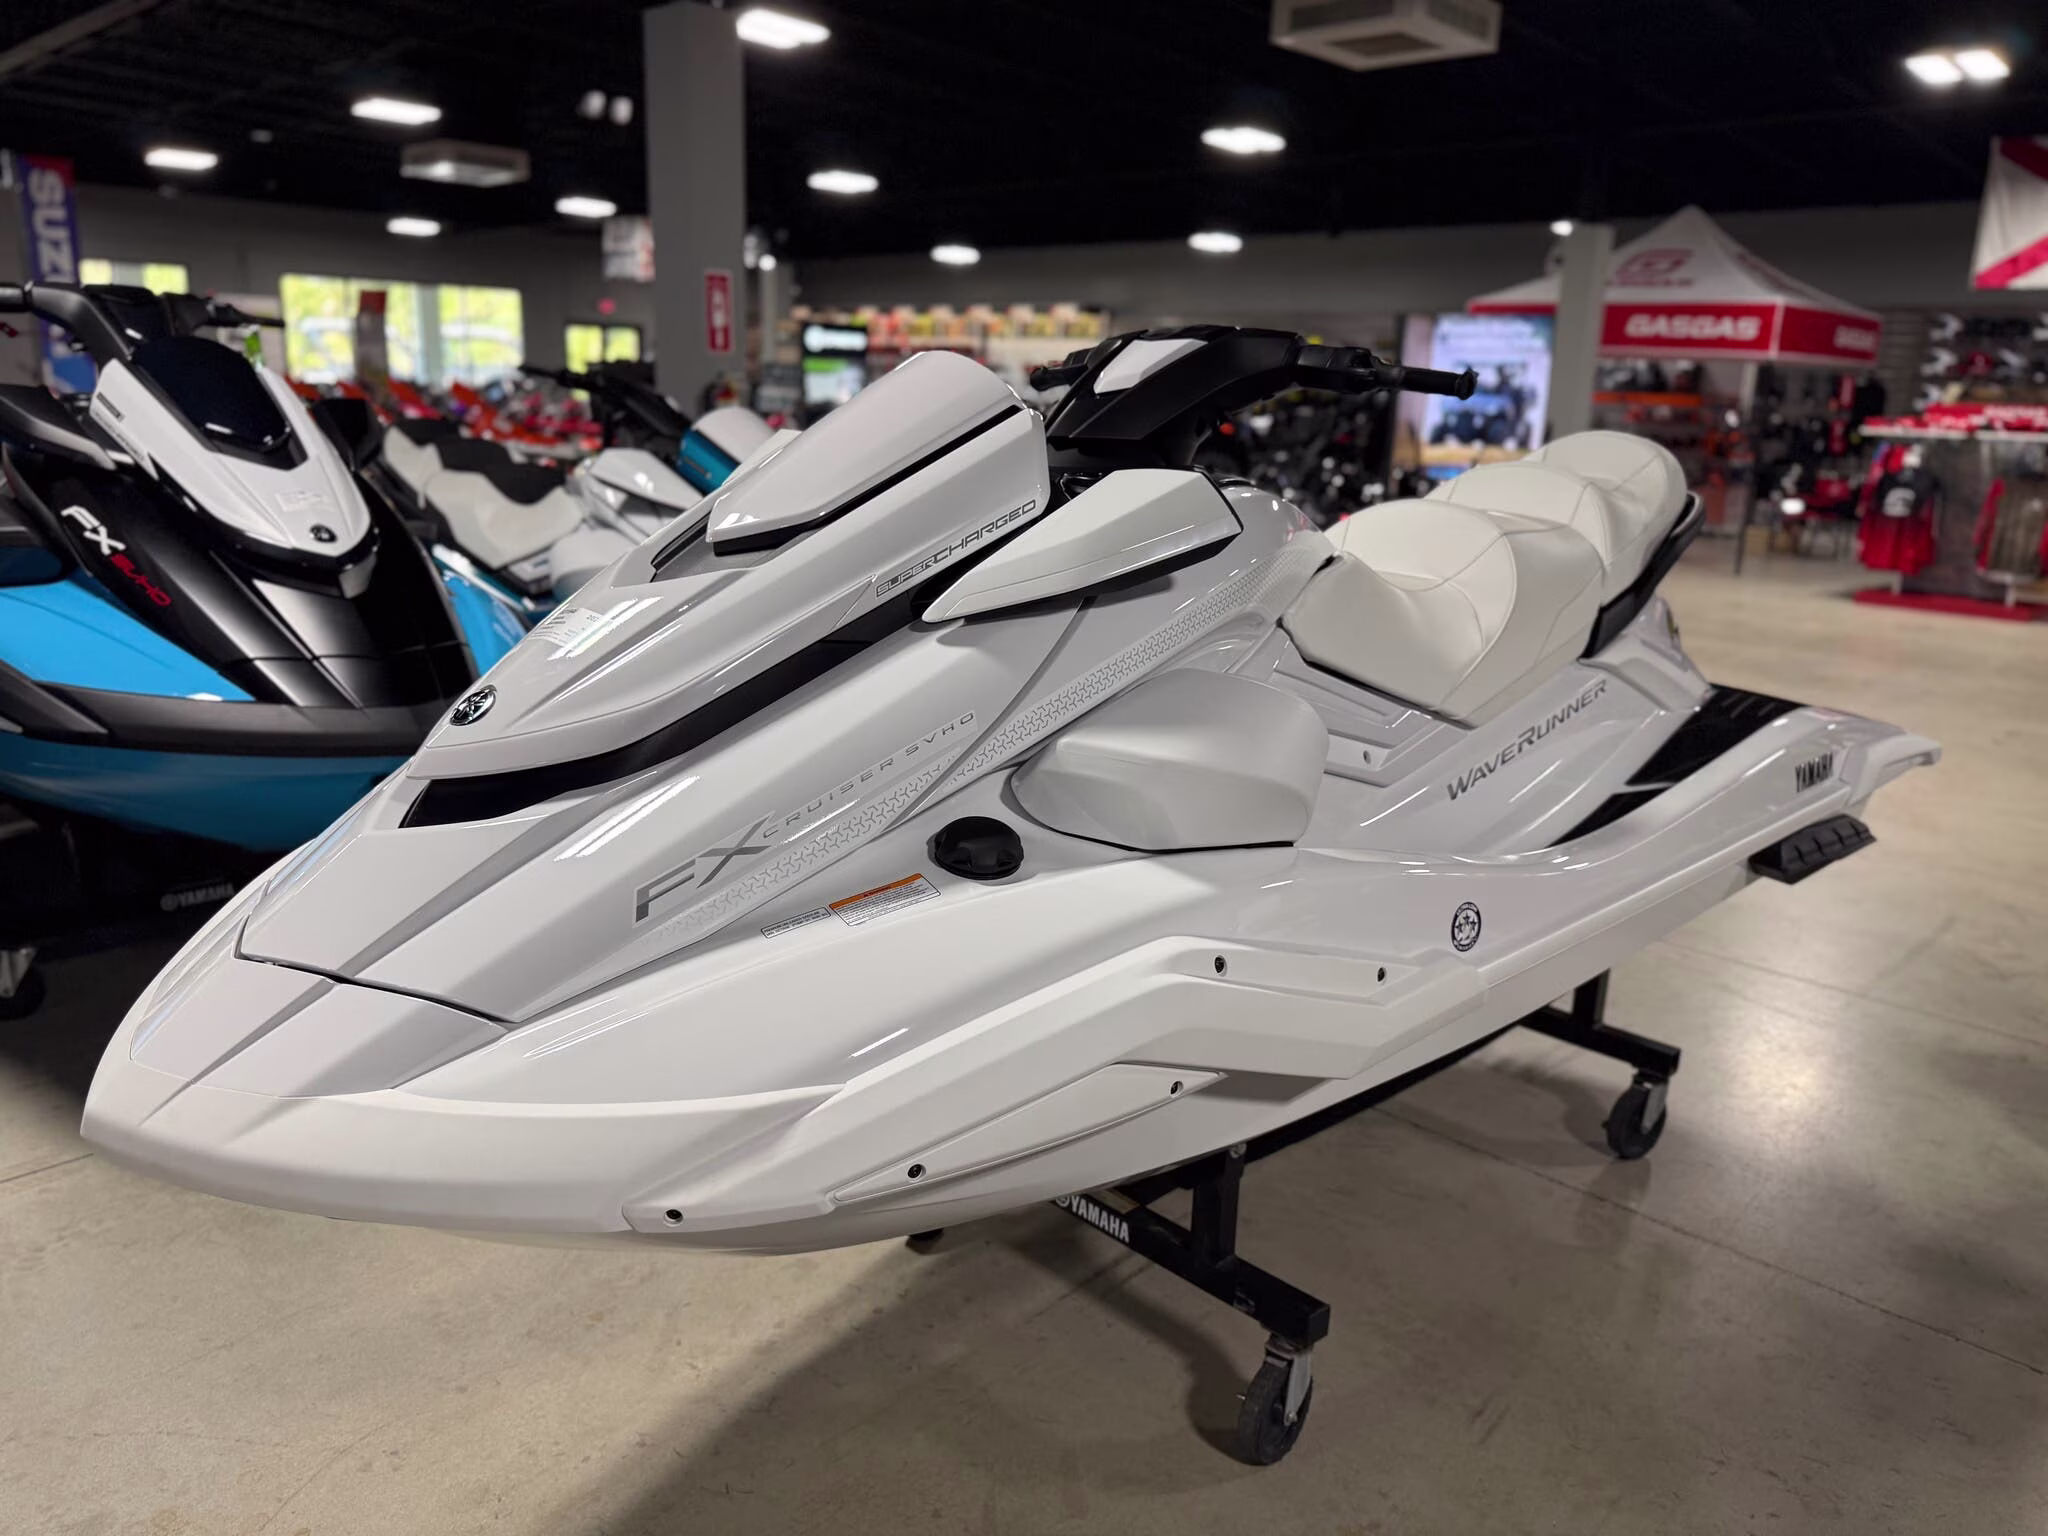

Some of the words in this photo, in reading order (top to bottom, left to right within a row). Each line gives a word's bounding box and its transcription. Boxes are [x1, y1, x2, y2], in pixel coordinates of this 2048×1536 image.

[1624, 312, 1762, 341] GASGAS
[61, 504, 127, 556] FX
[876, 499, 1037, 598] SUPERCHARGED
[1795, 752, 1834, 793] YAMAHA
[634, 814, 773, 923] FX
[762, 757, 895, 839] CRUISER
[904, 711, 975, 757] SVHO
[1071, 1195, 1130, 1243] YAMAHA
